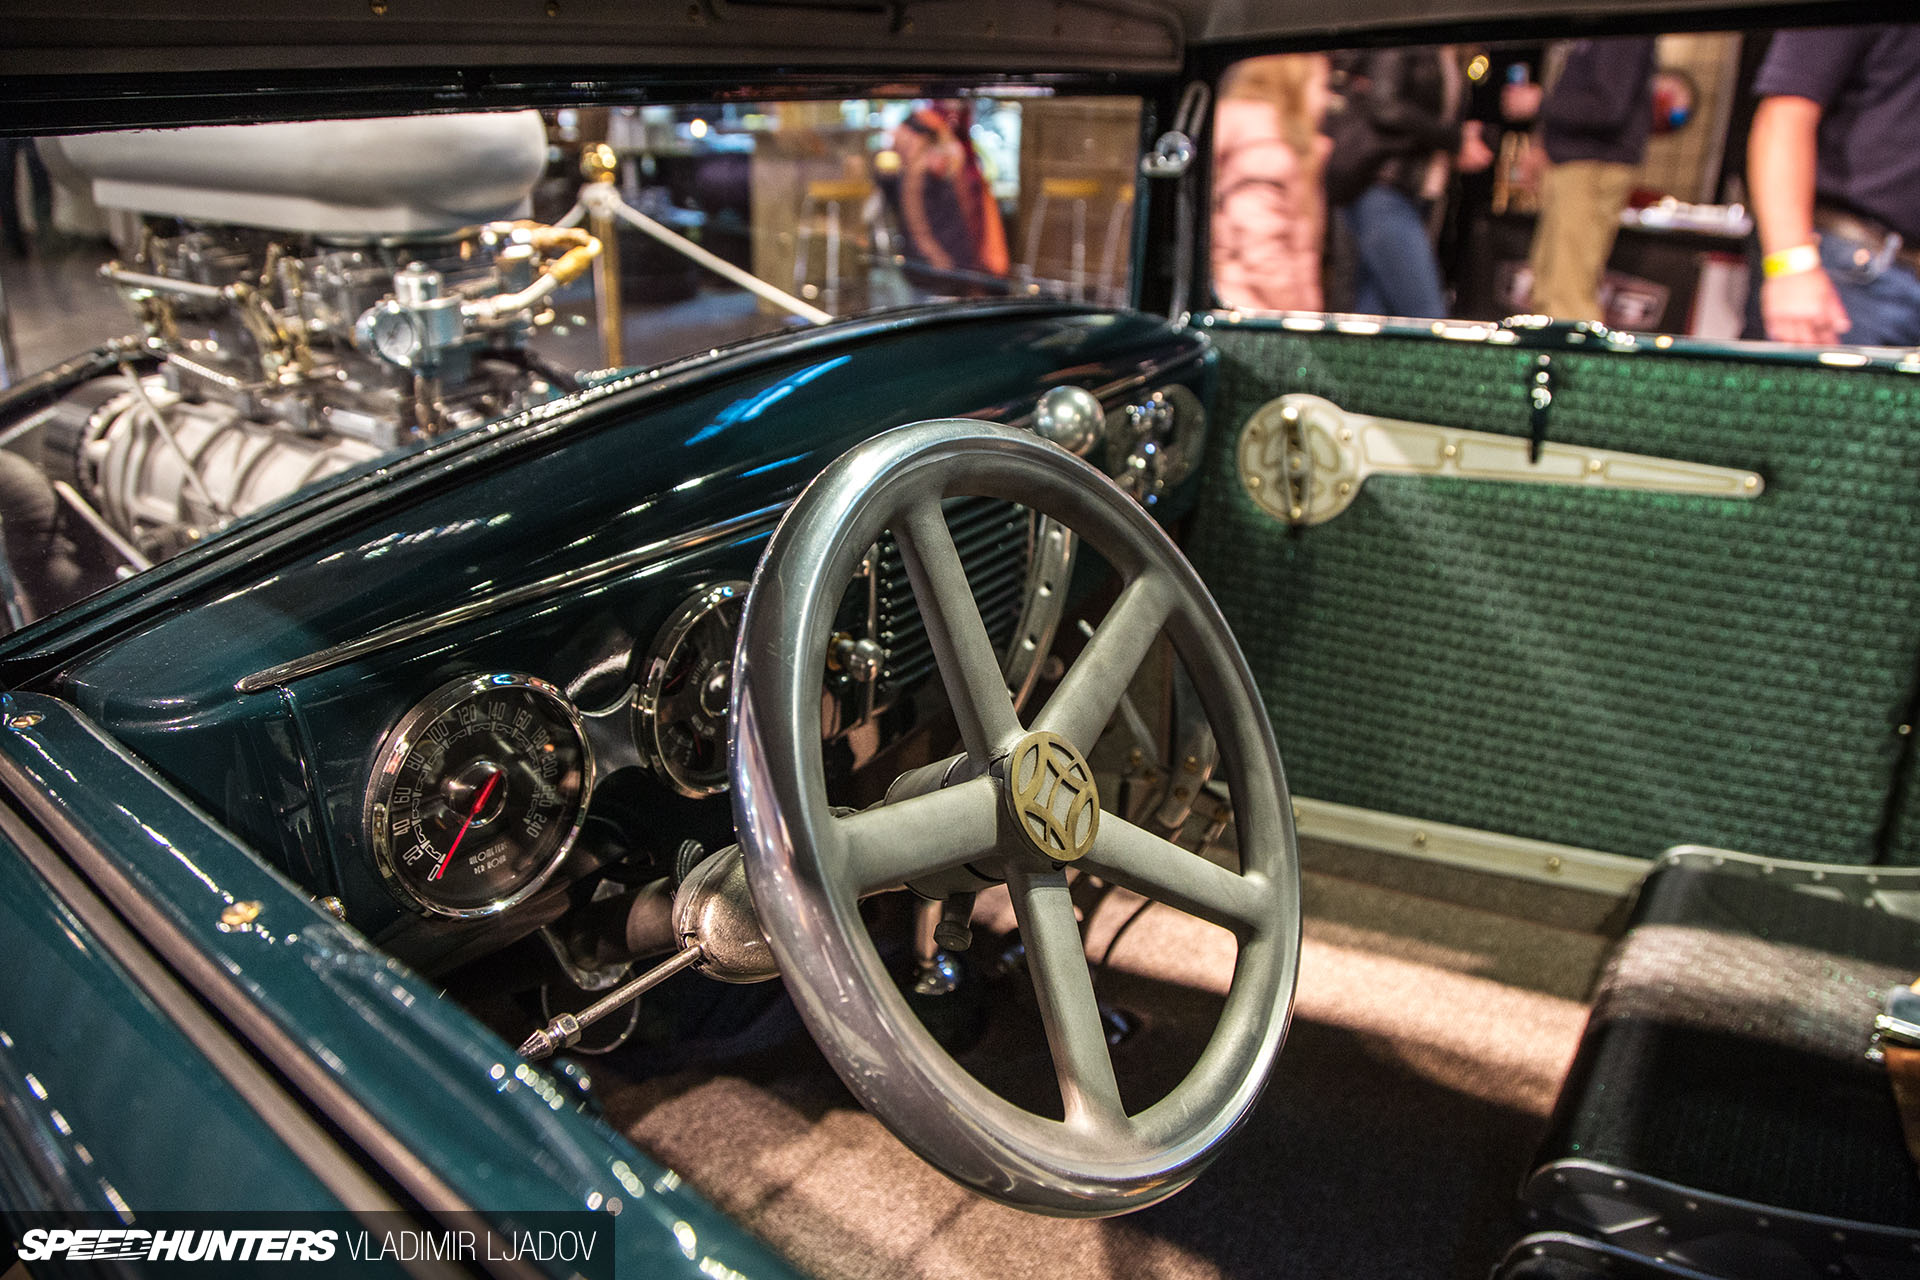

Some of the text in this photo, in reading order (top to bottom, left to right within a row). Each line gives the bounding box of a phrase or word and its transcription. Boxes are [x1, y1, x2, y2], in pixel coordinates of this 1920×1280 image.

[457, 704, 477, 725] 120
[488, 701, 507, 720] 140
[515, 708, 533, 730] 160
[427, 721, 449, 747] 100
[532, 726, 549, 748] 180
[406, 753, 425, 771] 80
[540, 754, 558, 778] 200
[394, 786, 413, 804] 60
[392, 818, 411, 836] 40
[526, 813, 548, 839] 240
[403, 844, 424, 866] 20
[427, 863, 442, 882] 0
